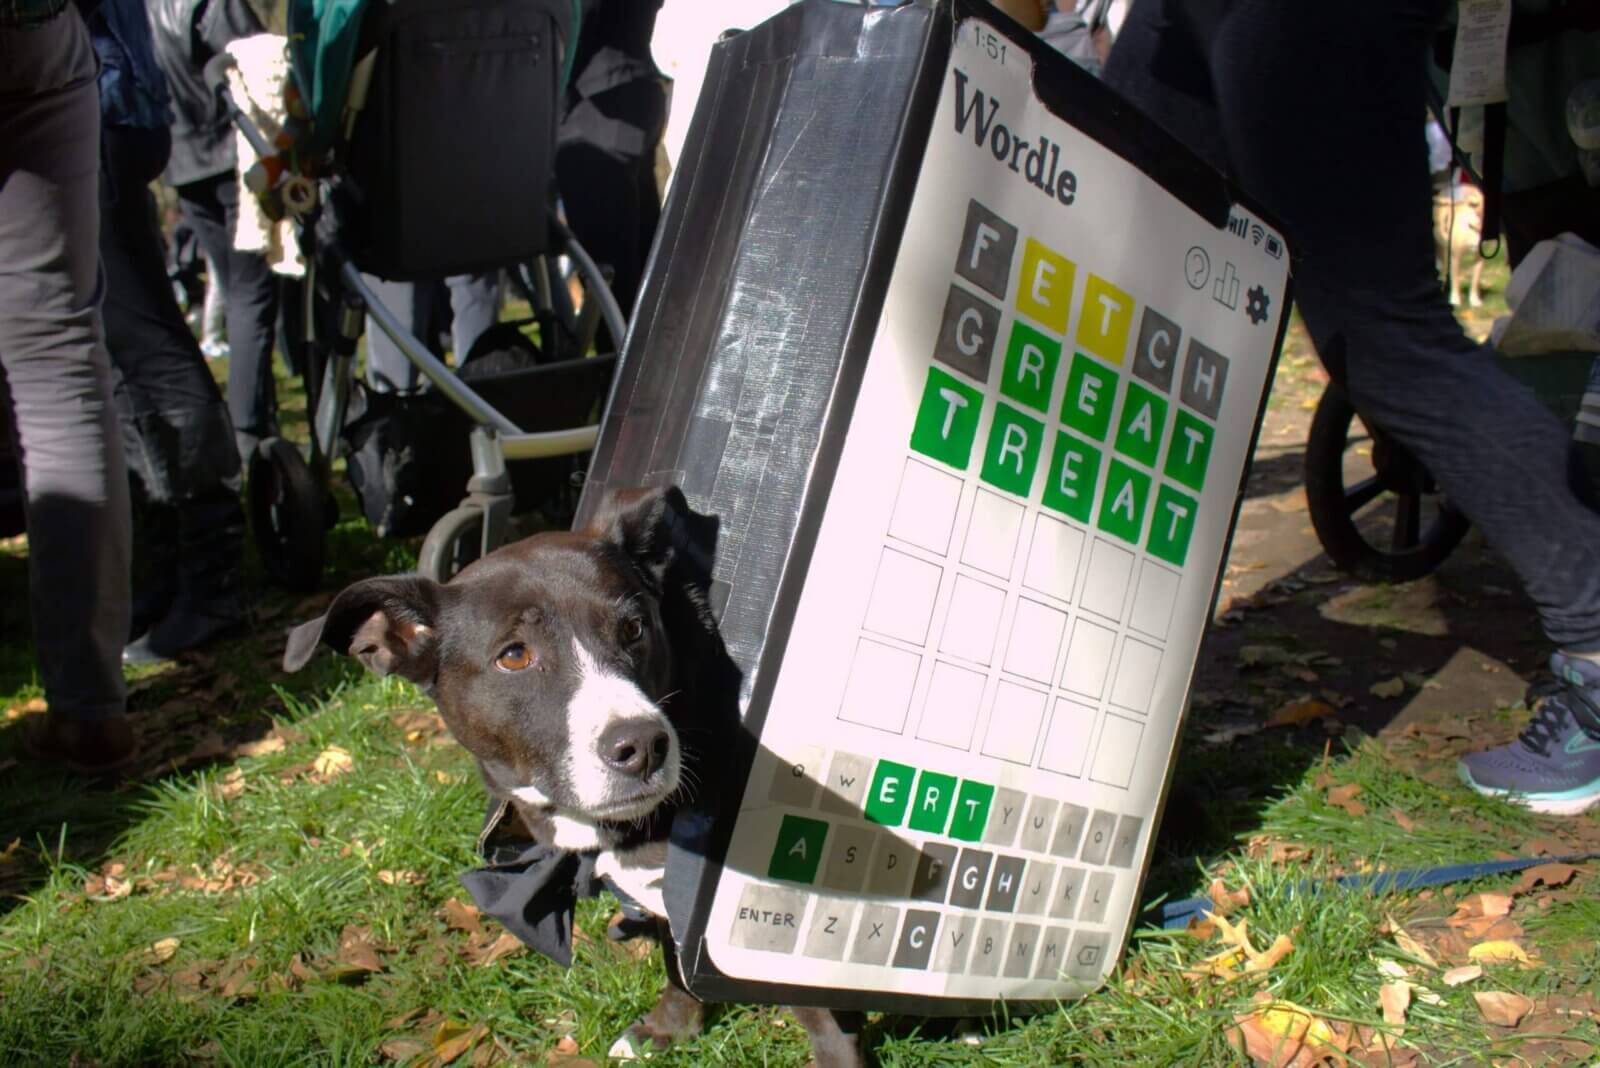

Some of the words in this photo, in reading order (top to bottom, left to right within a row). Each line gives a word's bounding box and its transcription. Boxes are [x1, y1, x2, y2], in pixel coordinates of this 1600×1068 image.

[974, 26, 1008, 66] 1:51
[952, 68, 1078, 206] Wordle
[738, 906, 796, 928] ENTER
